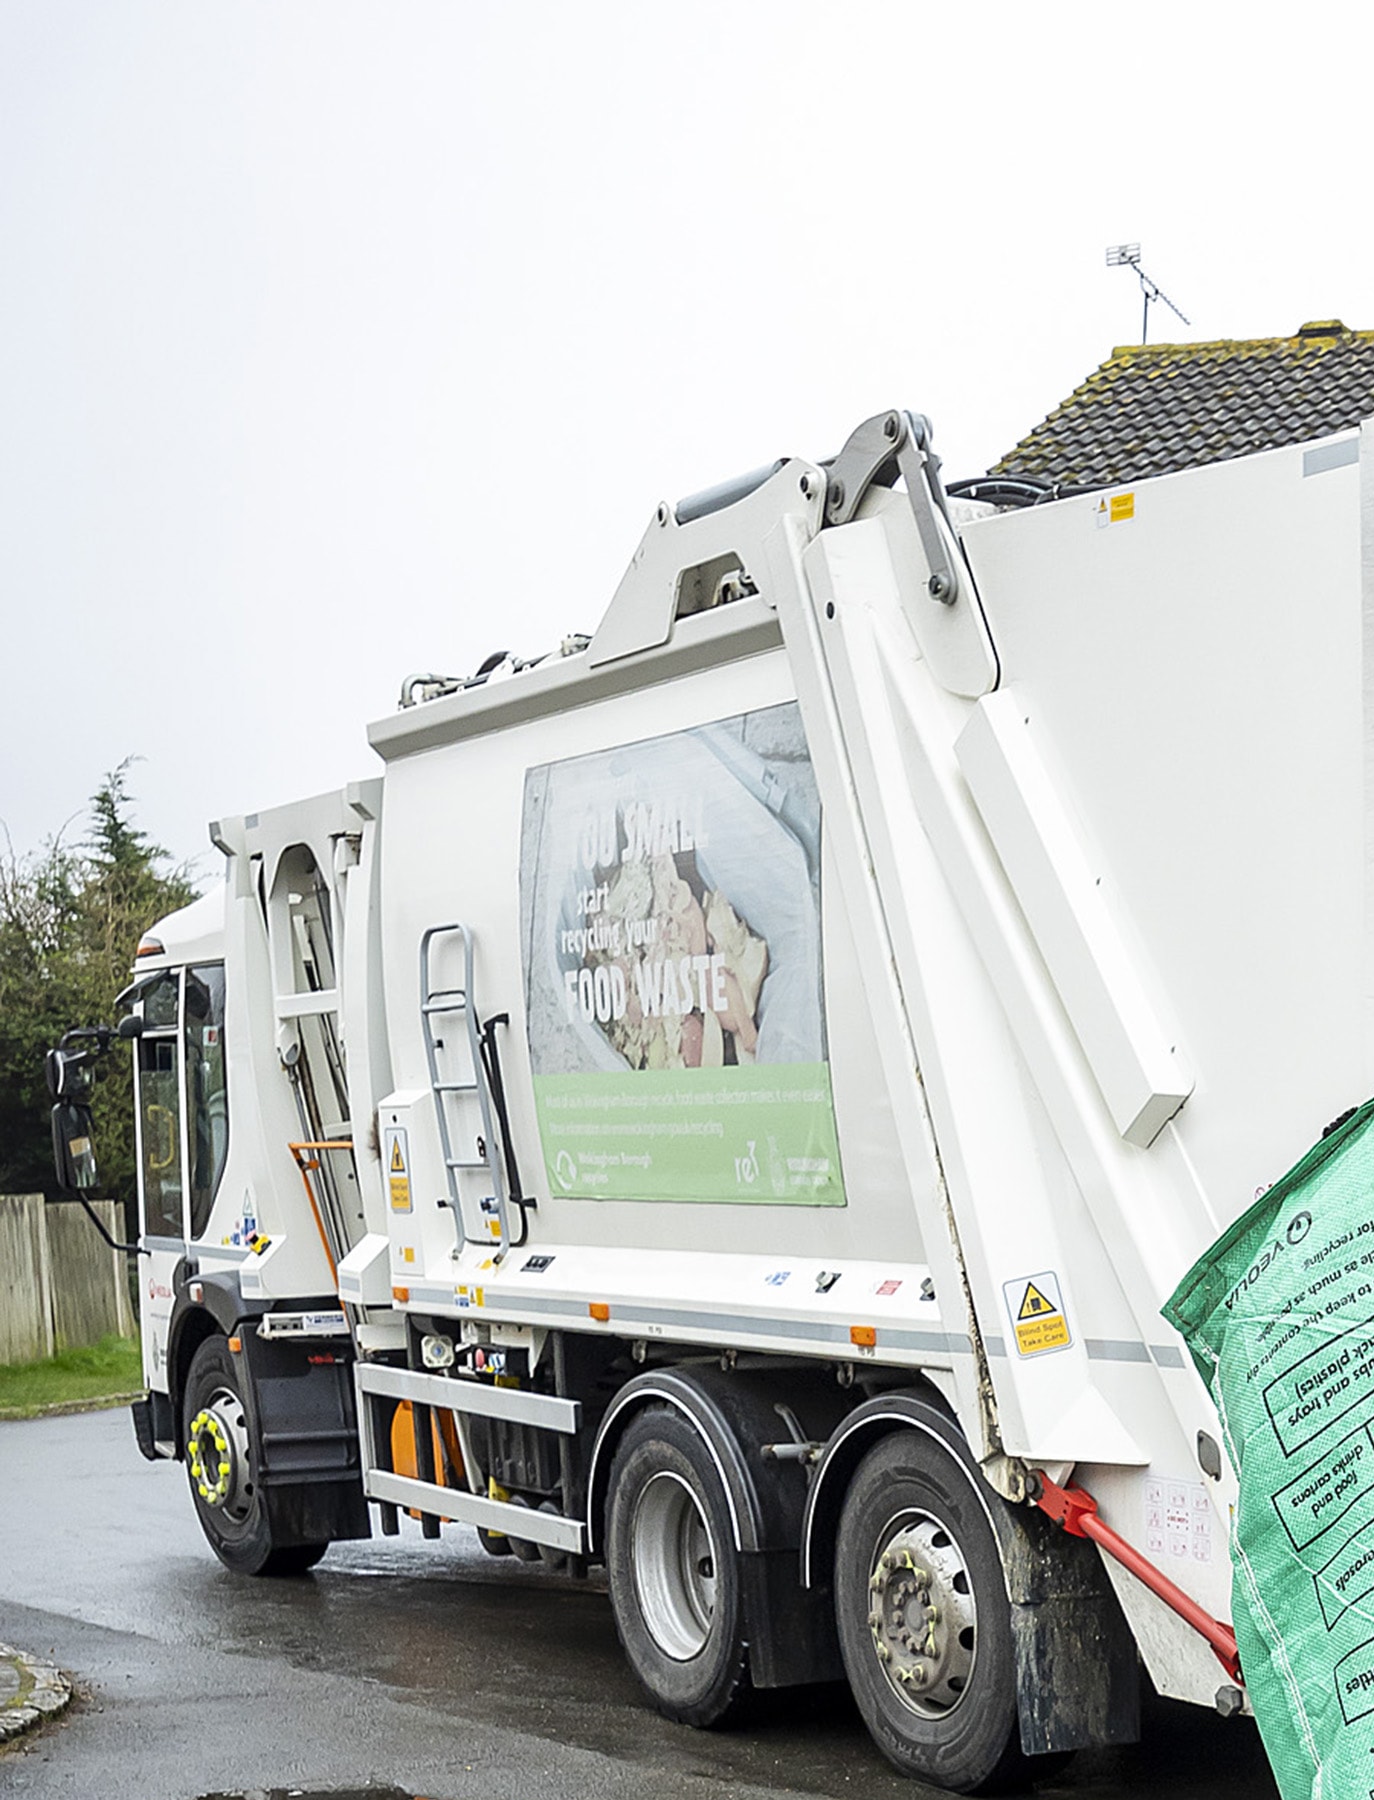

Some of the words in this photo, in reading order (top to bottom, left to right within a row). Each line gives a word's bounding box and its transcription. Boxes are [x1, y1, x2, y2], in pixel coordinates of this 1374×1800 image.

[576, 881, 609, 916] start
[561, 919, 620, 958] recycling
[625, 917, 659, 952] your
[565, 964, 627, 1023] FOOD
[635, 953, 729, 1018] WASTE
[1224, 1240, 1284, 1311] VEOLIA
[1344, 1261, 1358, 1275] as
[1308, 1270, 1342, 1296] much
[1358, 1283, 1372, 1296] to
[1293, 1291, 1306, 1305] as
[1325, 1293, 1356, 1314] keep
[1018, 1326, 1041, 1337] Blind
[1043, 1321, 1063, 1332] Spot
[1302, 1311, 1324, 1328] the
[1022, 1338, 1042, 1347] Take
[1044, 1333, 1064, 1342] Care
[1261, 1325, 1301, 1367] contents
[1295, 1349, 1351, 1402] plastics)
[1323, 1377, 1350, 1407] and
[1288, 1397, 1321, 1426] trays
[1332, 1445, 1363, 1474] drinks
[1291, 1473, 1331, 1508] cartons
[1334, 1471, 1358, 1500] food
[1311, 1493, 1333, 1519] and
